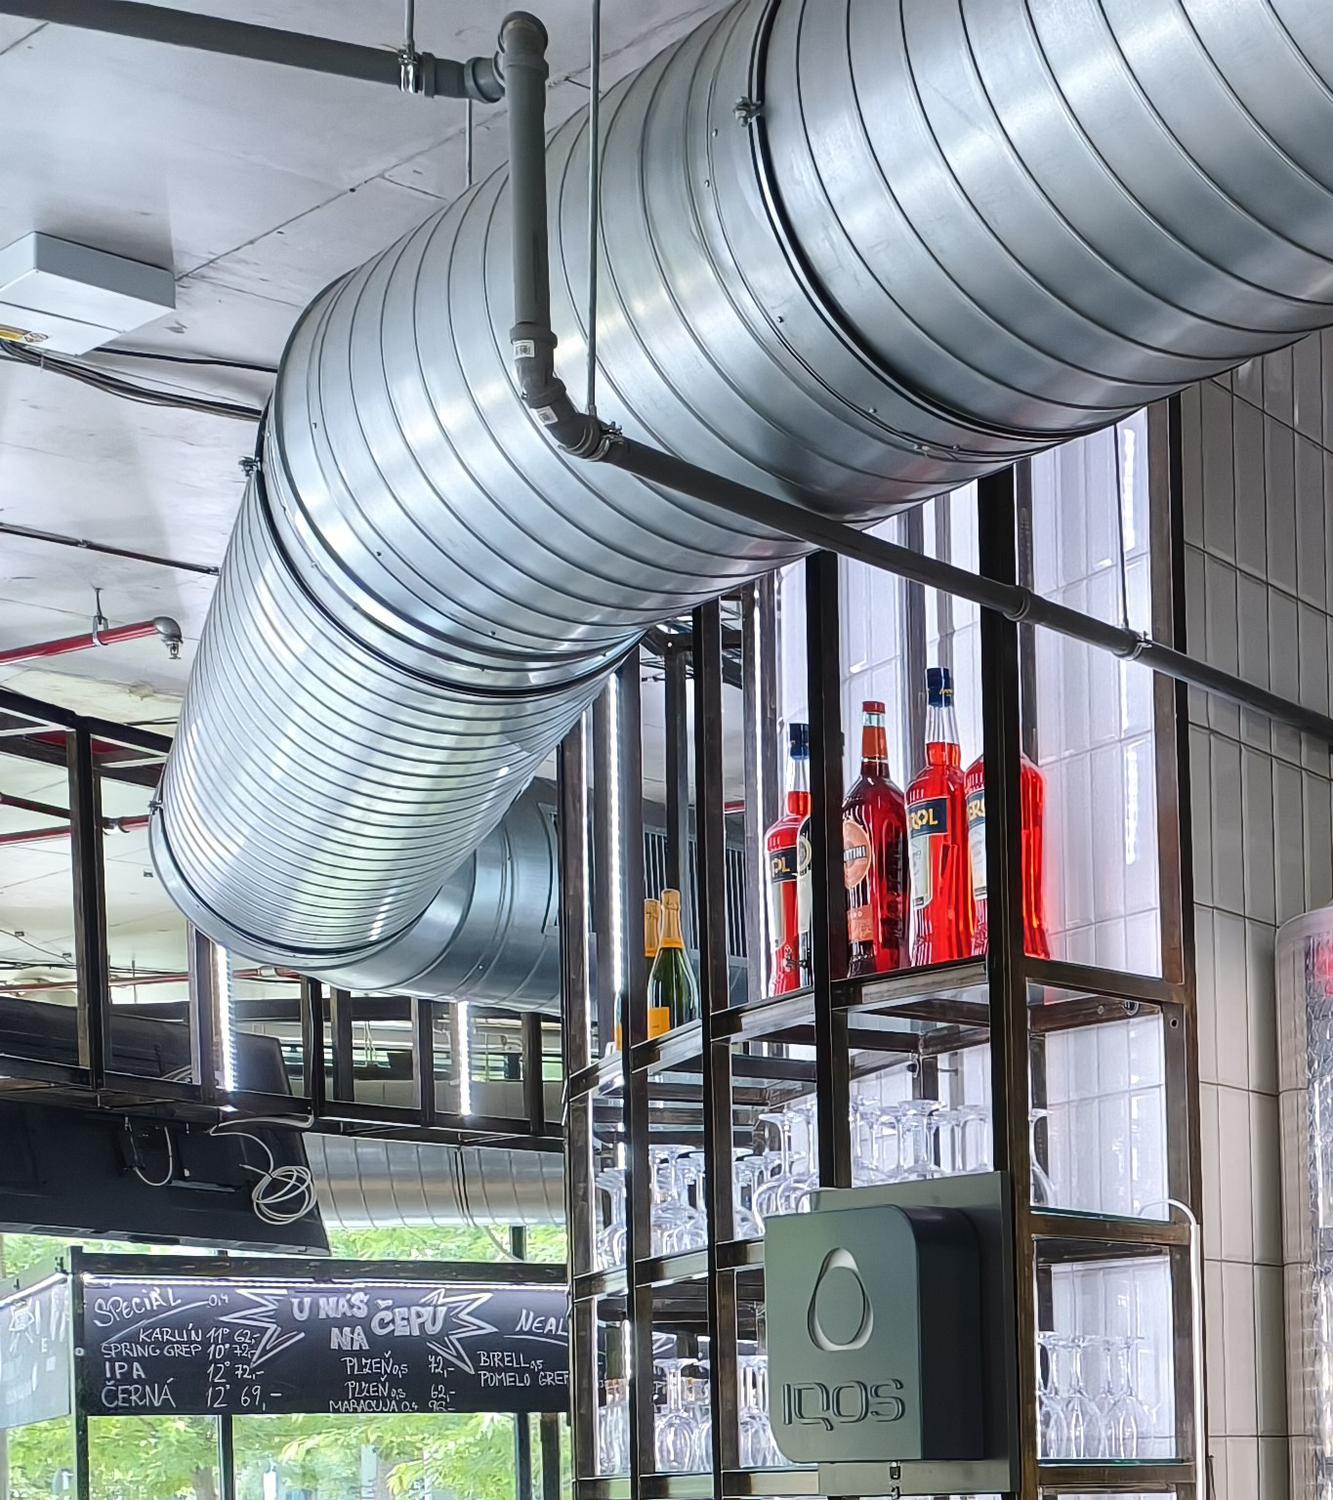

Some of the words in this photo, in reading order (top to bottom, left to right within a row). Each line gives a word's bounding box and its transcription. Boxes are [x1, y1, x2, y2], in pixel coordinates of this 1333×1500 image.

[292, 1298, 312, 1321] U
[318, 1291, 370, 1319] NÁS
[330, 1325, 370, 1350] NA
[370, 1299, 448, 1336] ČEPU
[515, 1309, 568, 1336] NEAL
[101, 1343, 160, 1358] SPRING
[163, 1344, 202, 1357] GREP
[477, 1351, 530, 1368] BIRELL
[105, 1361, 146, 1379] IPA
[478, 1371, 530, 1387] POMELO
[101, 1377, 177, 1408] ČERNÁ
[782, 1378, 906, 1431] IQOS
